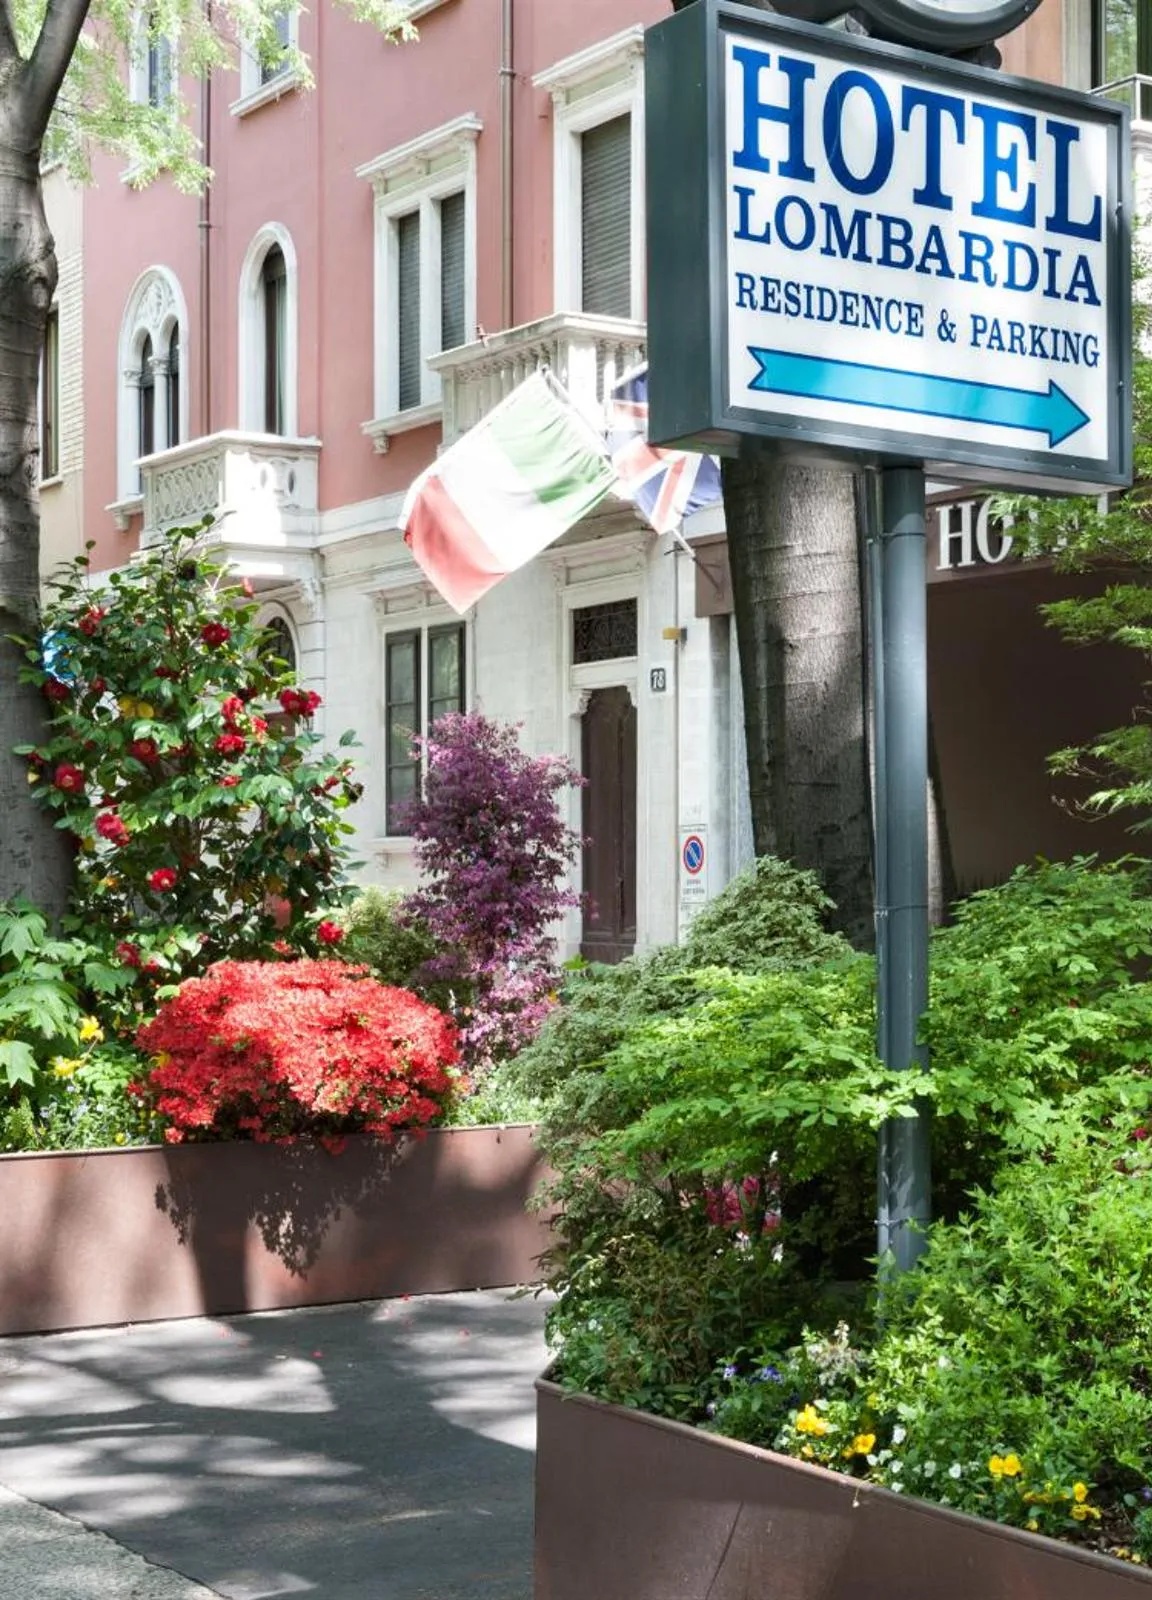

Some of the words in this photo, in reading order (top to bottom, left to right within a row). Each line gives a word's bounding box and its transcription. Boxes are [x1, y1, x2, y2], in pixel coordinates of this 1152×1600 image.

[732, 45, 1102, 242] HOTEL
[733, 185, 1102, 307] LOMBARDIA
[735, 272, 924, 338] RESIDENCE
[937, 309, 957, 343] &
[970, 313, 1100, 368] PARKING
